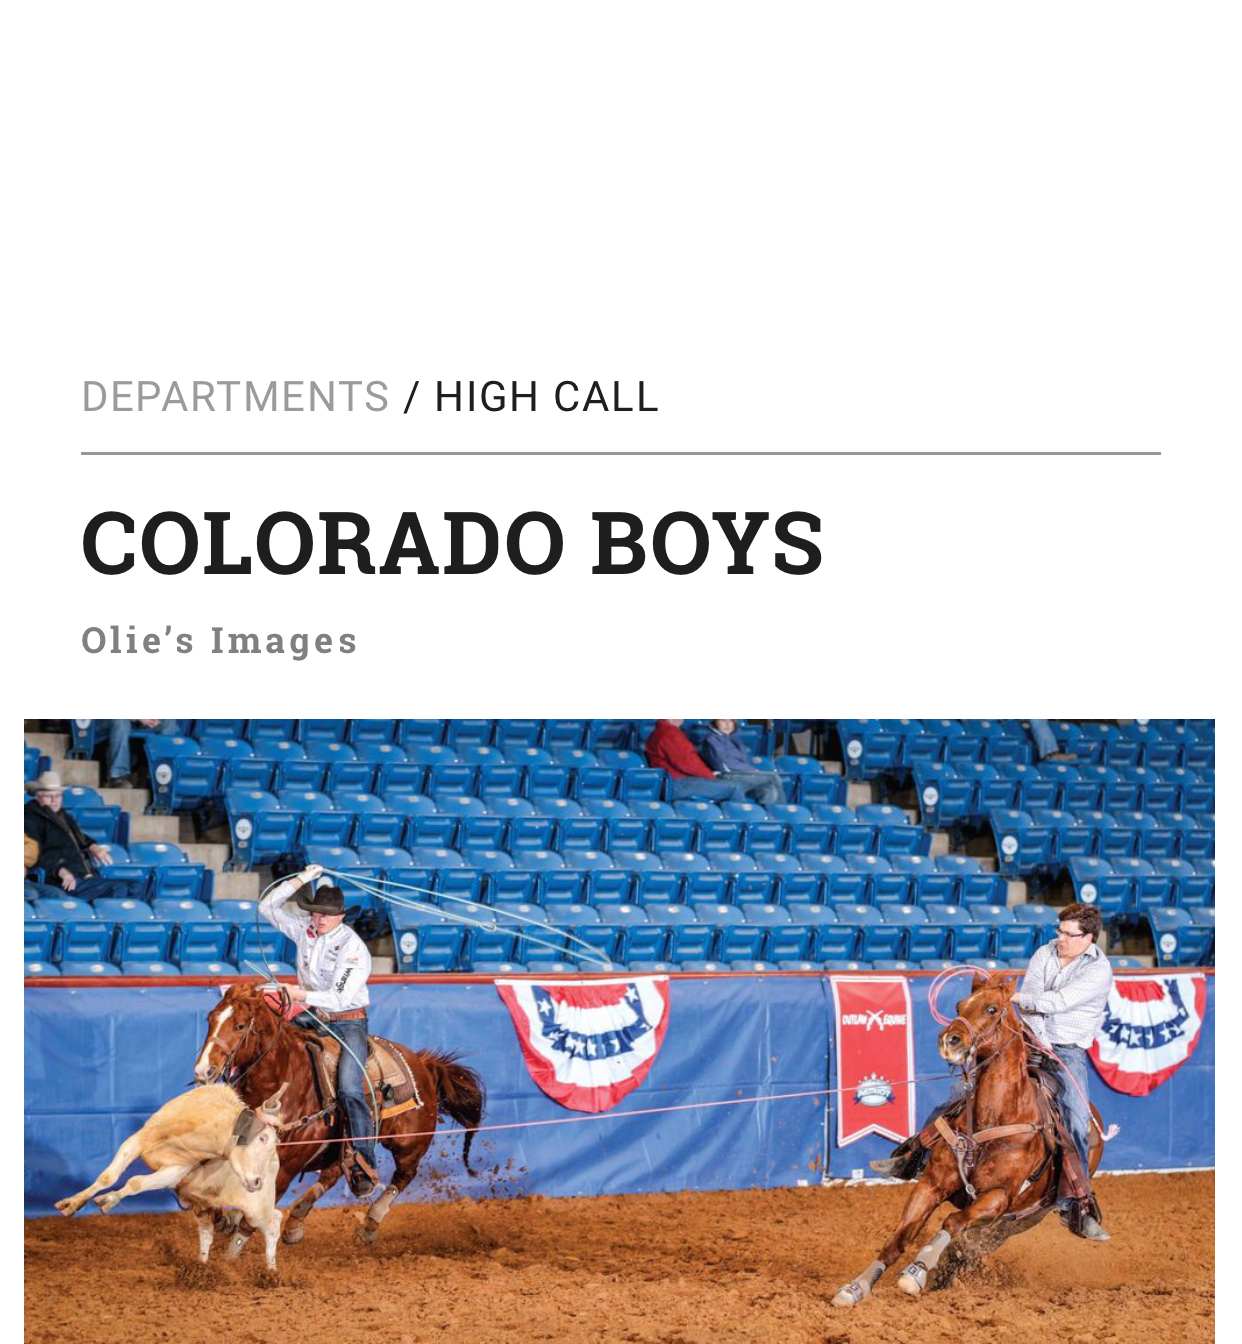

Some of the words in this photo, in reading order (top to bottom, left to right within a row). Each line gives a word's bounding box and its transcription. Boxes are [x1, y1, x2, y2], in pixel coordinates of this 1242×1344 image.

[83, 381, 388, 413] DEPARTMENTS
[402, 381, 420, 415] /
[436, 381, 537, 413] HIGH
[554, 381, 659, 413] CALL
[82, 510, 564, 576] COLORADO
[591, 510, 822, 576] BOYS
[81, 625, 193, 655] Olie’s
[211, 626, 356, 662] Images
